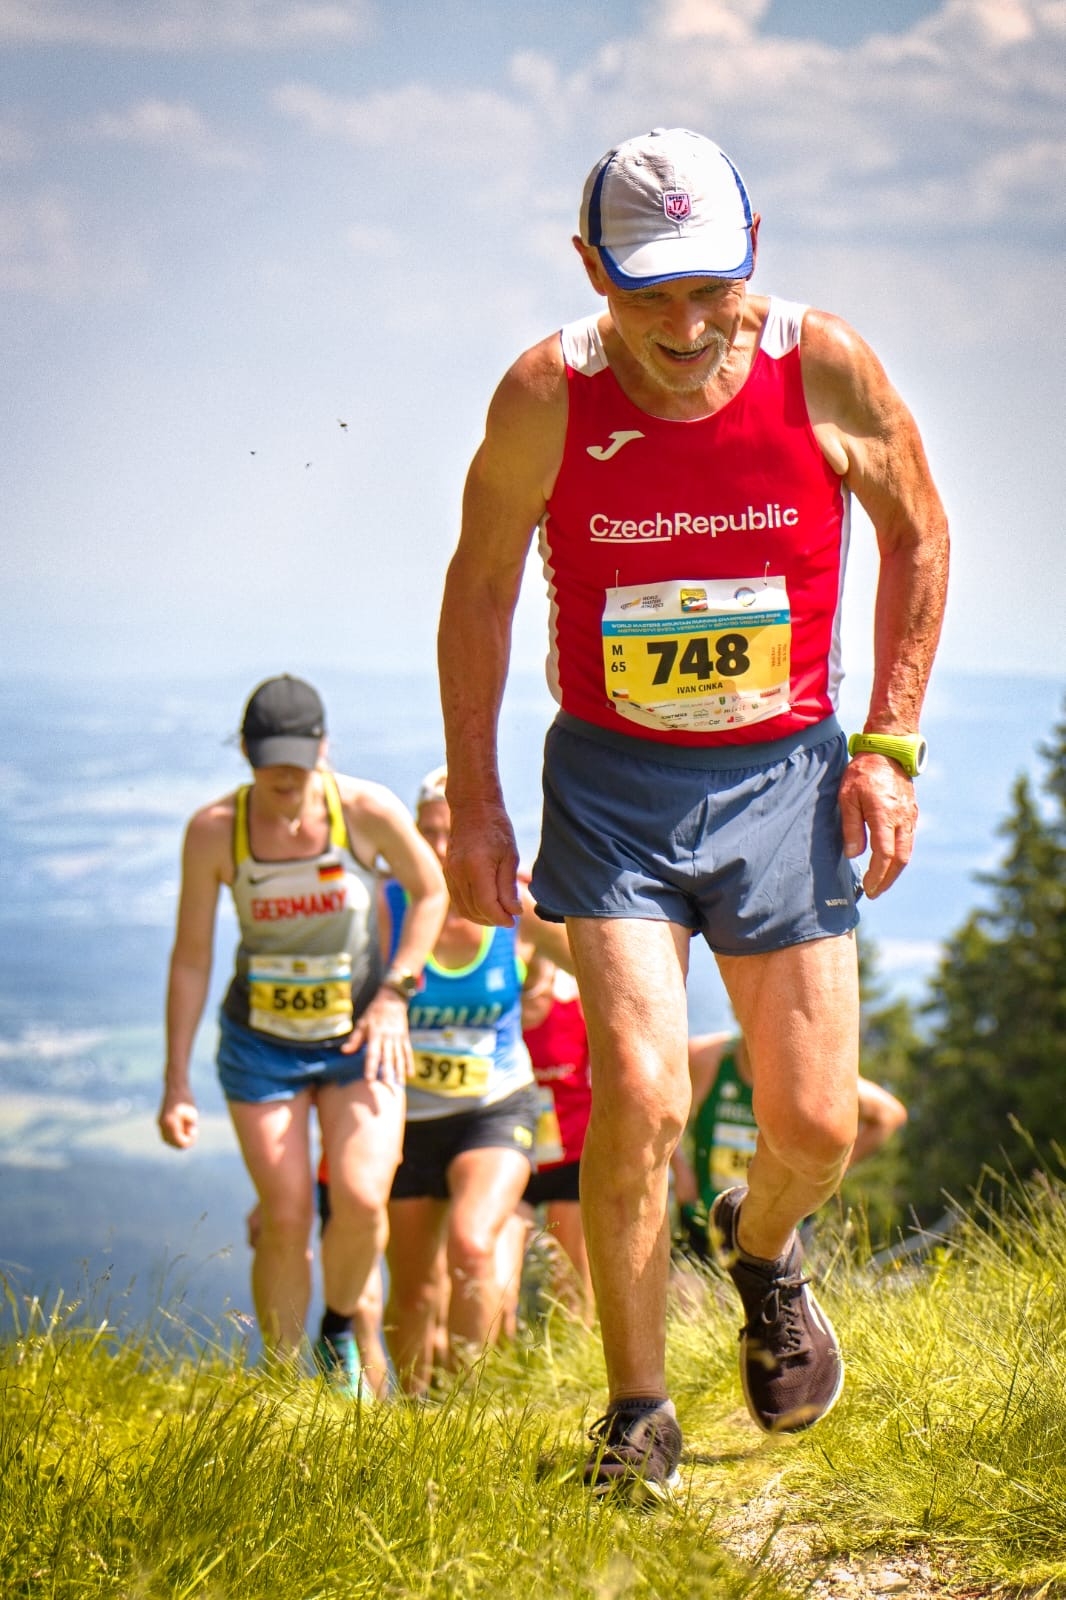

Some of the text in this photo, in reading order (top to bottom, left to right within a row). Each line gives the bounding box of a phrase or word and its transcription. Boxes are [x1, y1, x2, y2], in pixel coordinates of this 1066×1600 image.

[673, 200, 684, 211] 17
[612, 645, 623, 655] M
[611, 661, 626, 673] 65
[647, 633, 750, 686] 748
[677, 681, 724, 695] IVAN CINKA
[250, 889, 348, 922] GERMANY
[273, 988, 329, 1011] 568
[418, 1056, 469, 1085] 391
